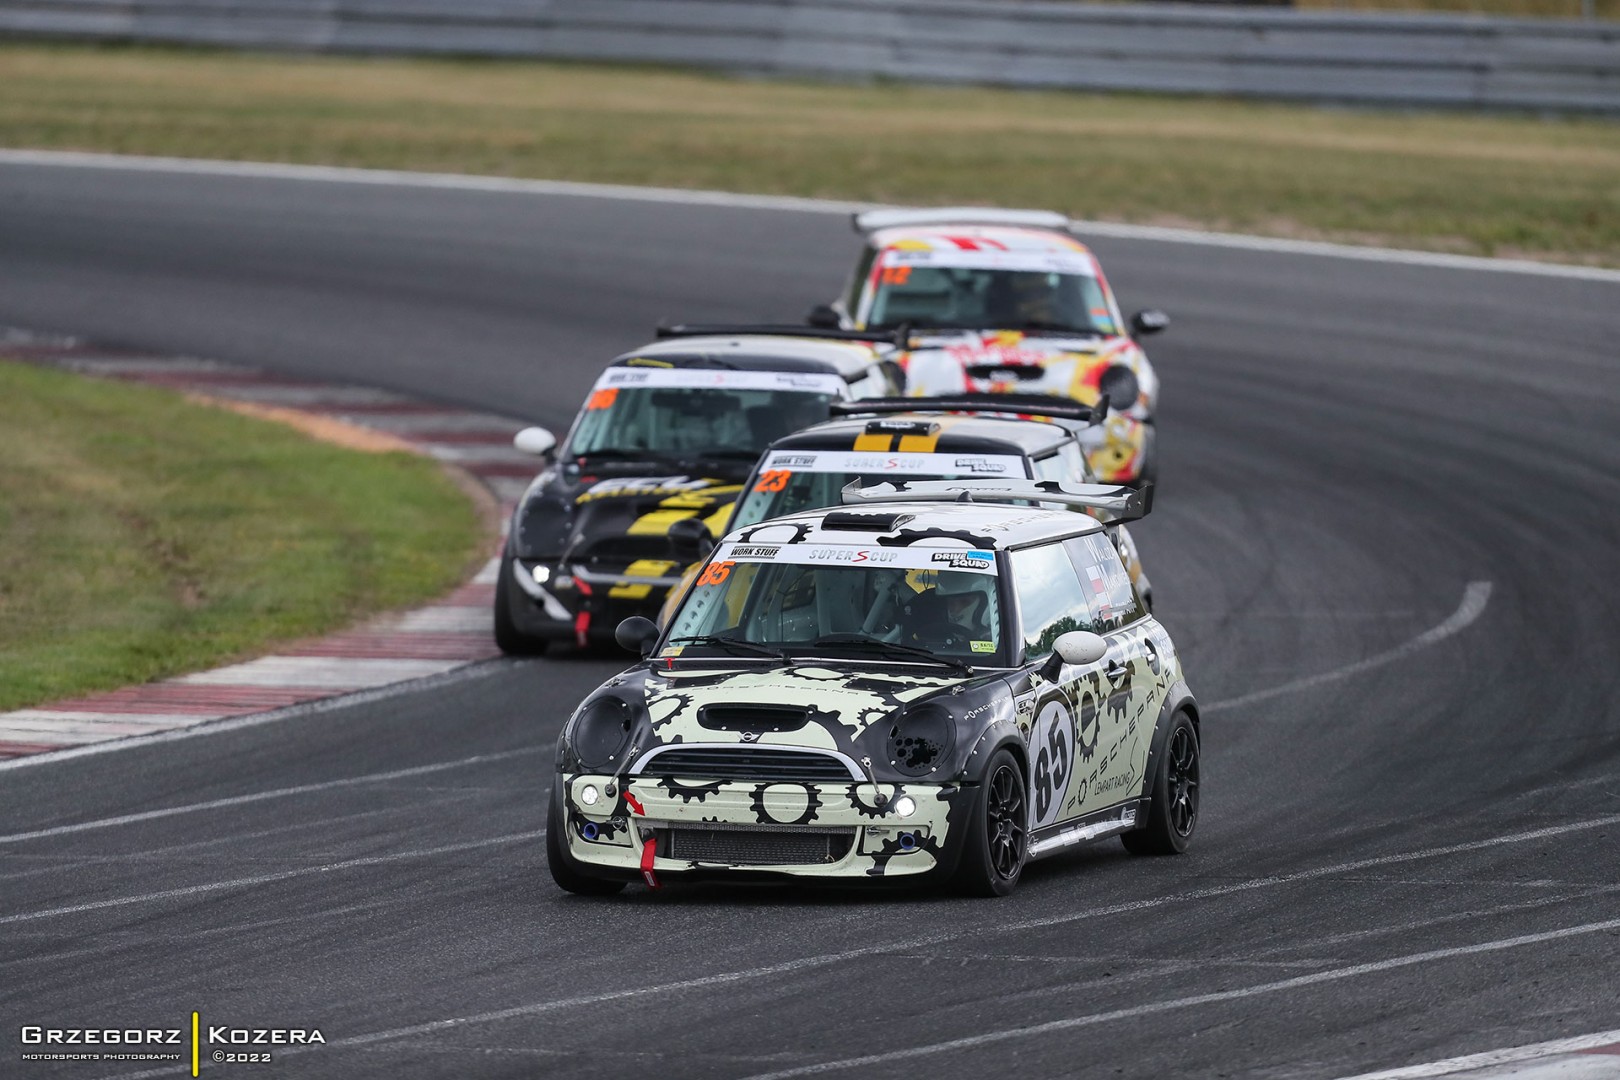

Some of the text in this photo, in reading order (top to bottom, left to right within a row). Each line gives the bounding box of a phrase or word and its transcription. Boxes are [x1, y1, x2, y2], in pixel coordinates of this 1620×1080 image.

[753, 470, 792, 492] 23
[730, 546, 780, 557] WORK STUFF
[696, 561, 736, 586] 85
[1034, 710, 1068, 823] 85
